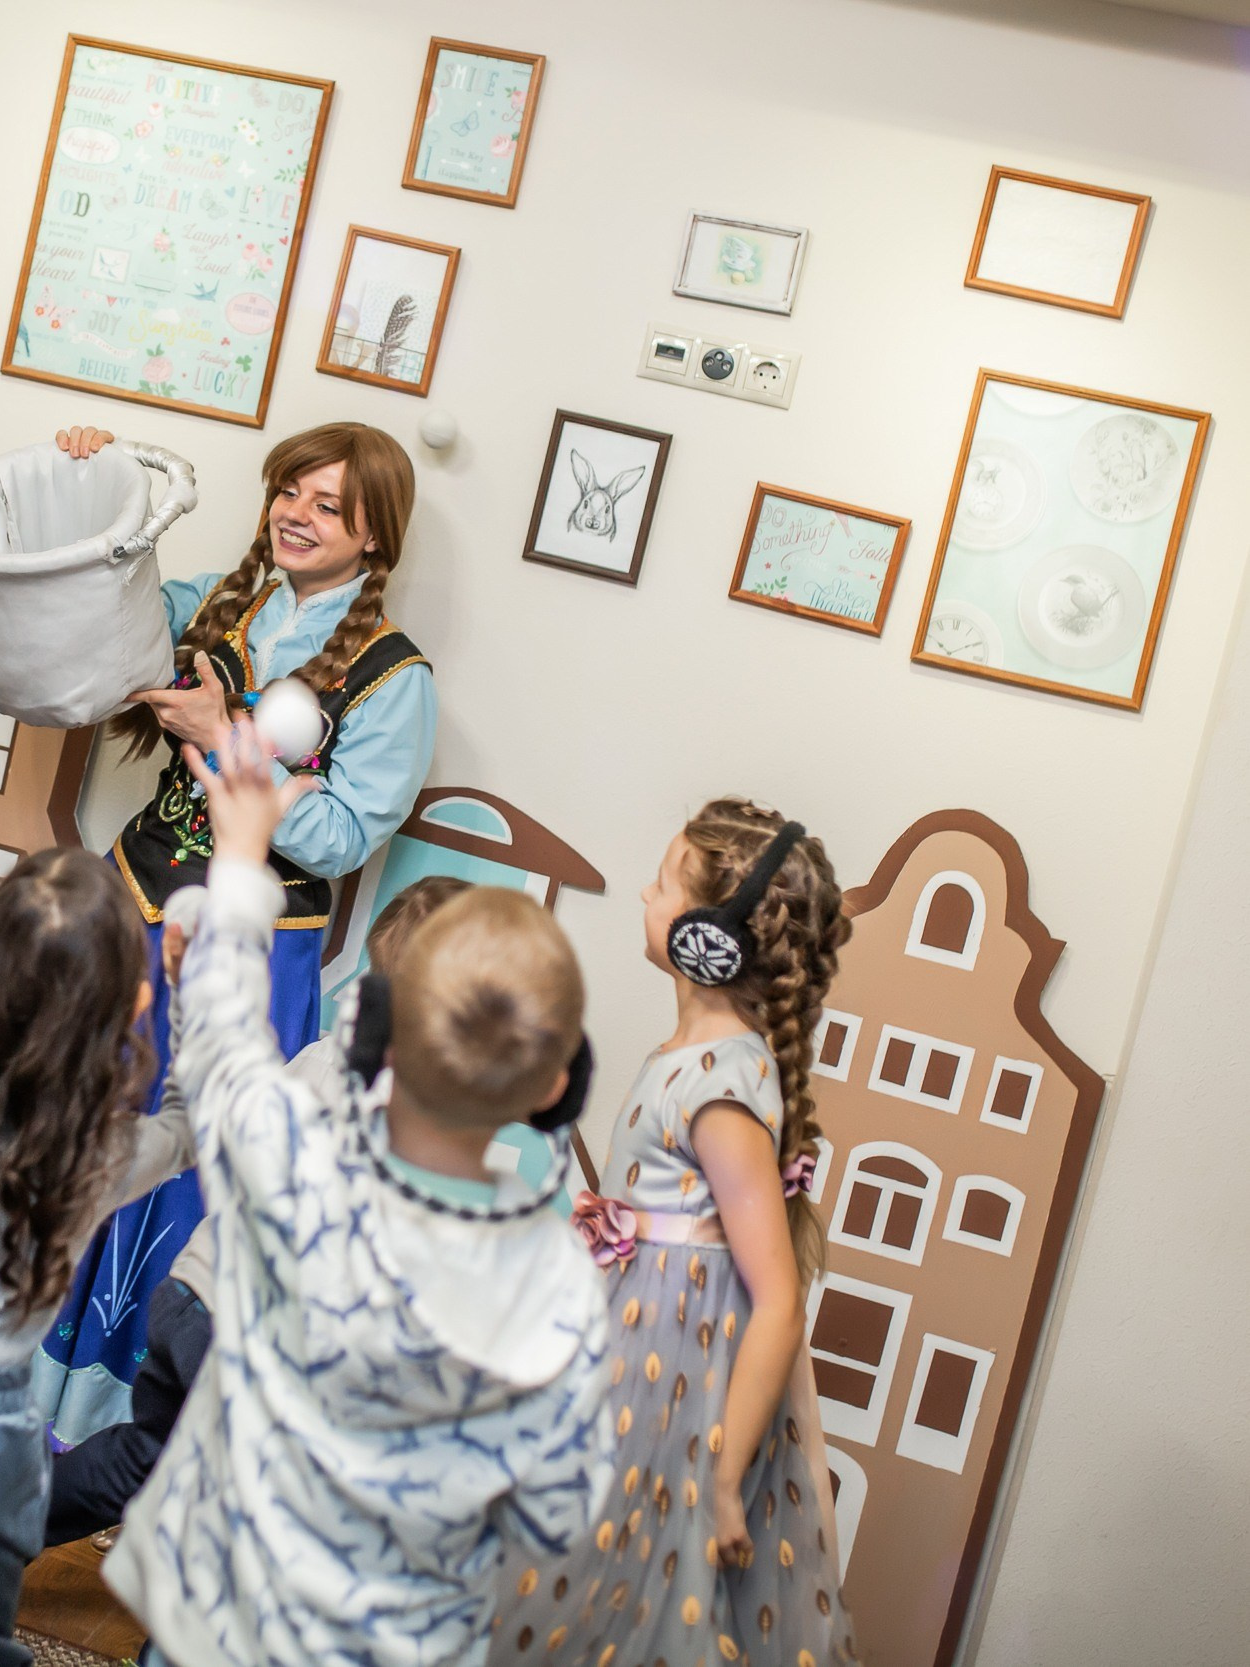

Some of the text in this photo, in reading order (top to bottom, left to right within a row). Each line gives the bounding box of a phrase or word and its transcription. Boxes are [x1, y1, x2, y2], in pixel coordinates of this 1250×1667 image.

[145, 73, 222, 106] POSITIVE
[278, 90, 305, 114] DO
[75, 108, 117, 127] THINK
[66, 131, 112, 162] happy
[165, 125, 236, 152] EVERYDAY
[134, 183, 192, 214] DREAM
[238, 185, 296, 220] LVE
[182, 223, 230, 250] Laugh
[50, 246, 86, 261] your
[195, 255, 232, 275] Loud
[88, 310, 122, 336] JOY
[78, 357, 129, 384] BELIEVE
[193, 367, 250, 400] LUCKY
[759, 502, 787, 527] DO
[750, 514, 834, 556] Something
